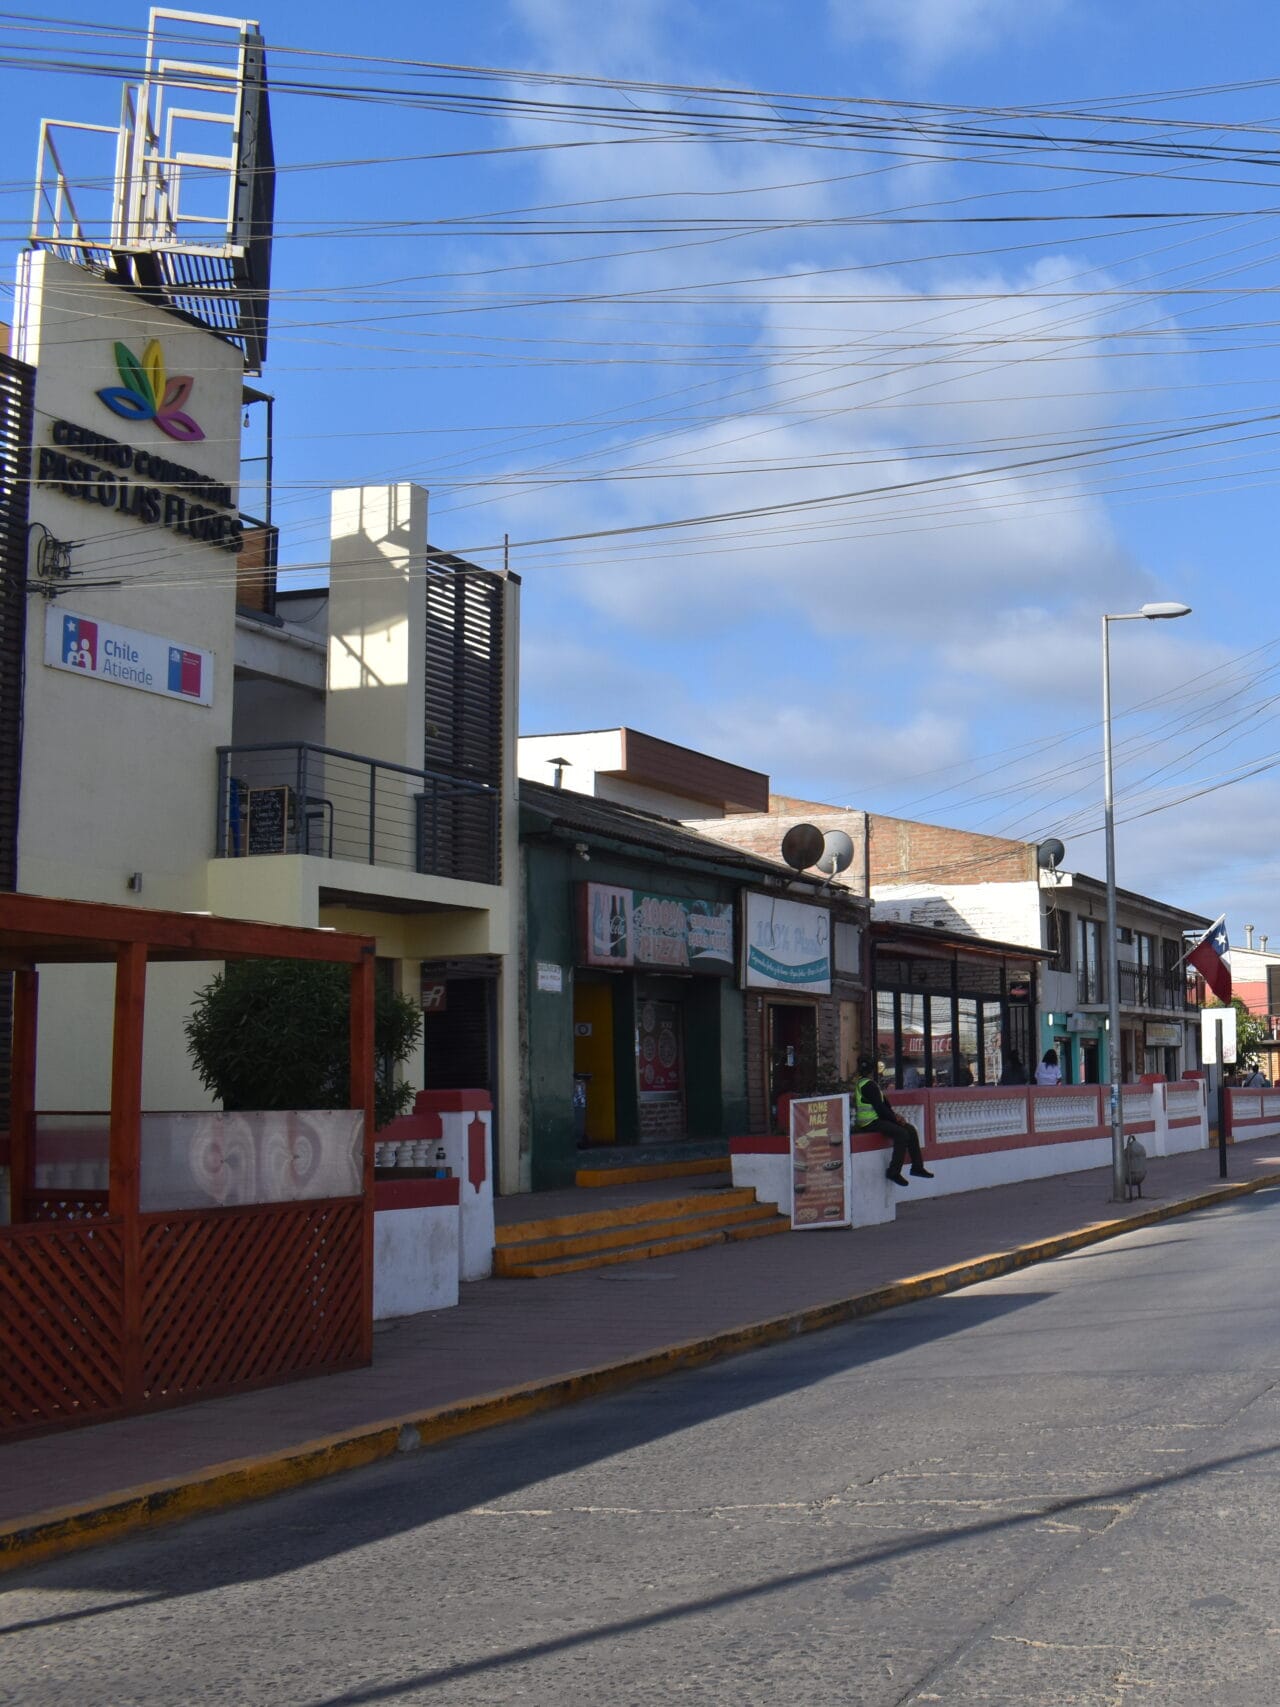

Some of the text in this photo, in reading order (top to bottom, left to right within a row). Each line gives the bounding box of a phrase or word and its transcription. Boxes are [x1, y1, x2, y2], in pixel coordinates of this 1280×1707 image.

[53, 420, 235, 509] CENTRO COMERCIAL
[37, 447, 243, 552] PASEO LAS FLORES
[102, 659, 153, 686] Atiende
[104, 640, 139, 663] Chile
